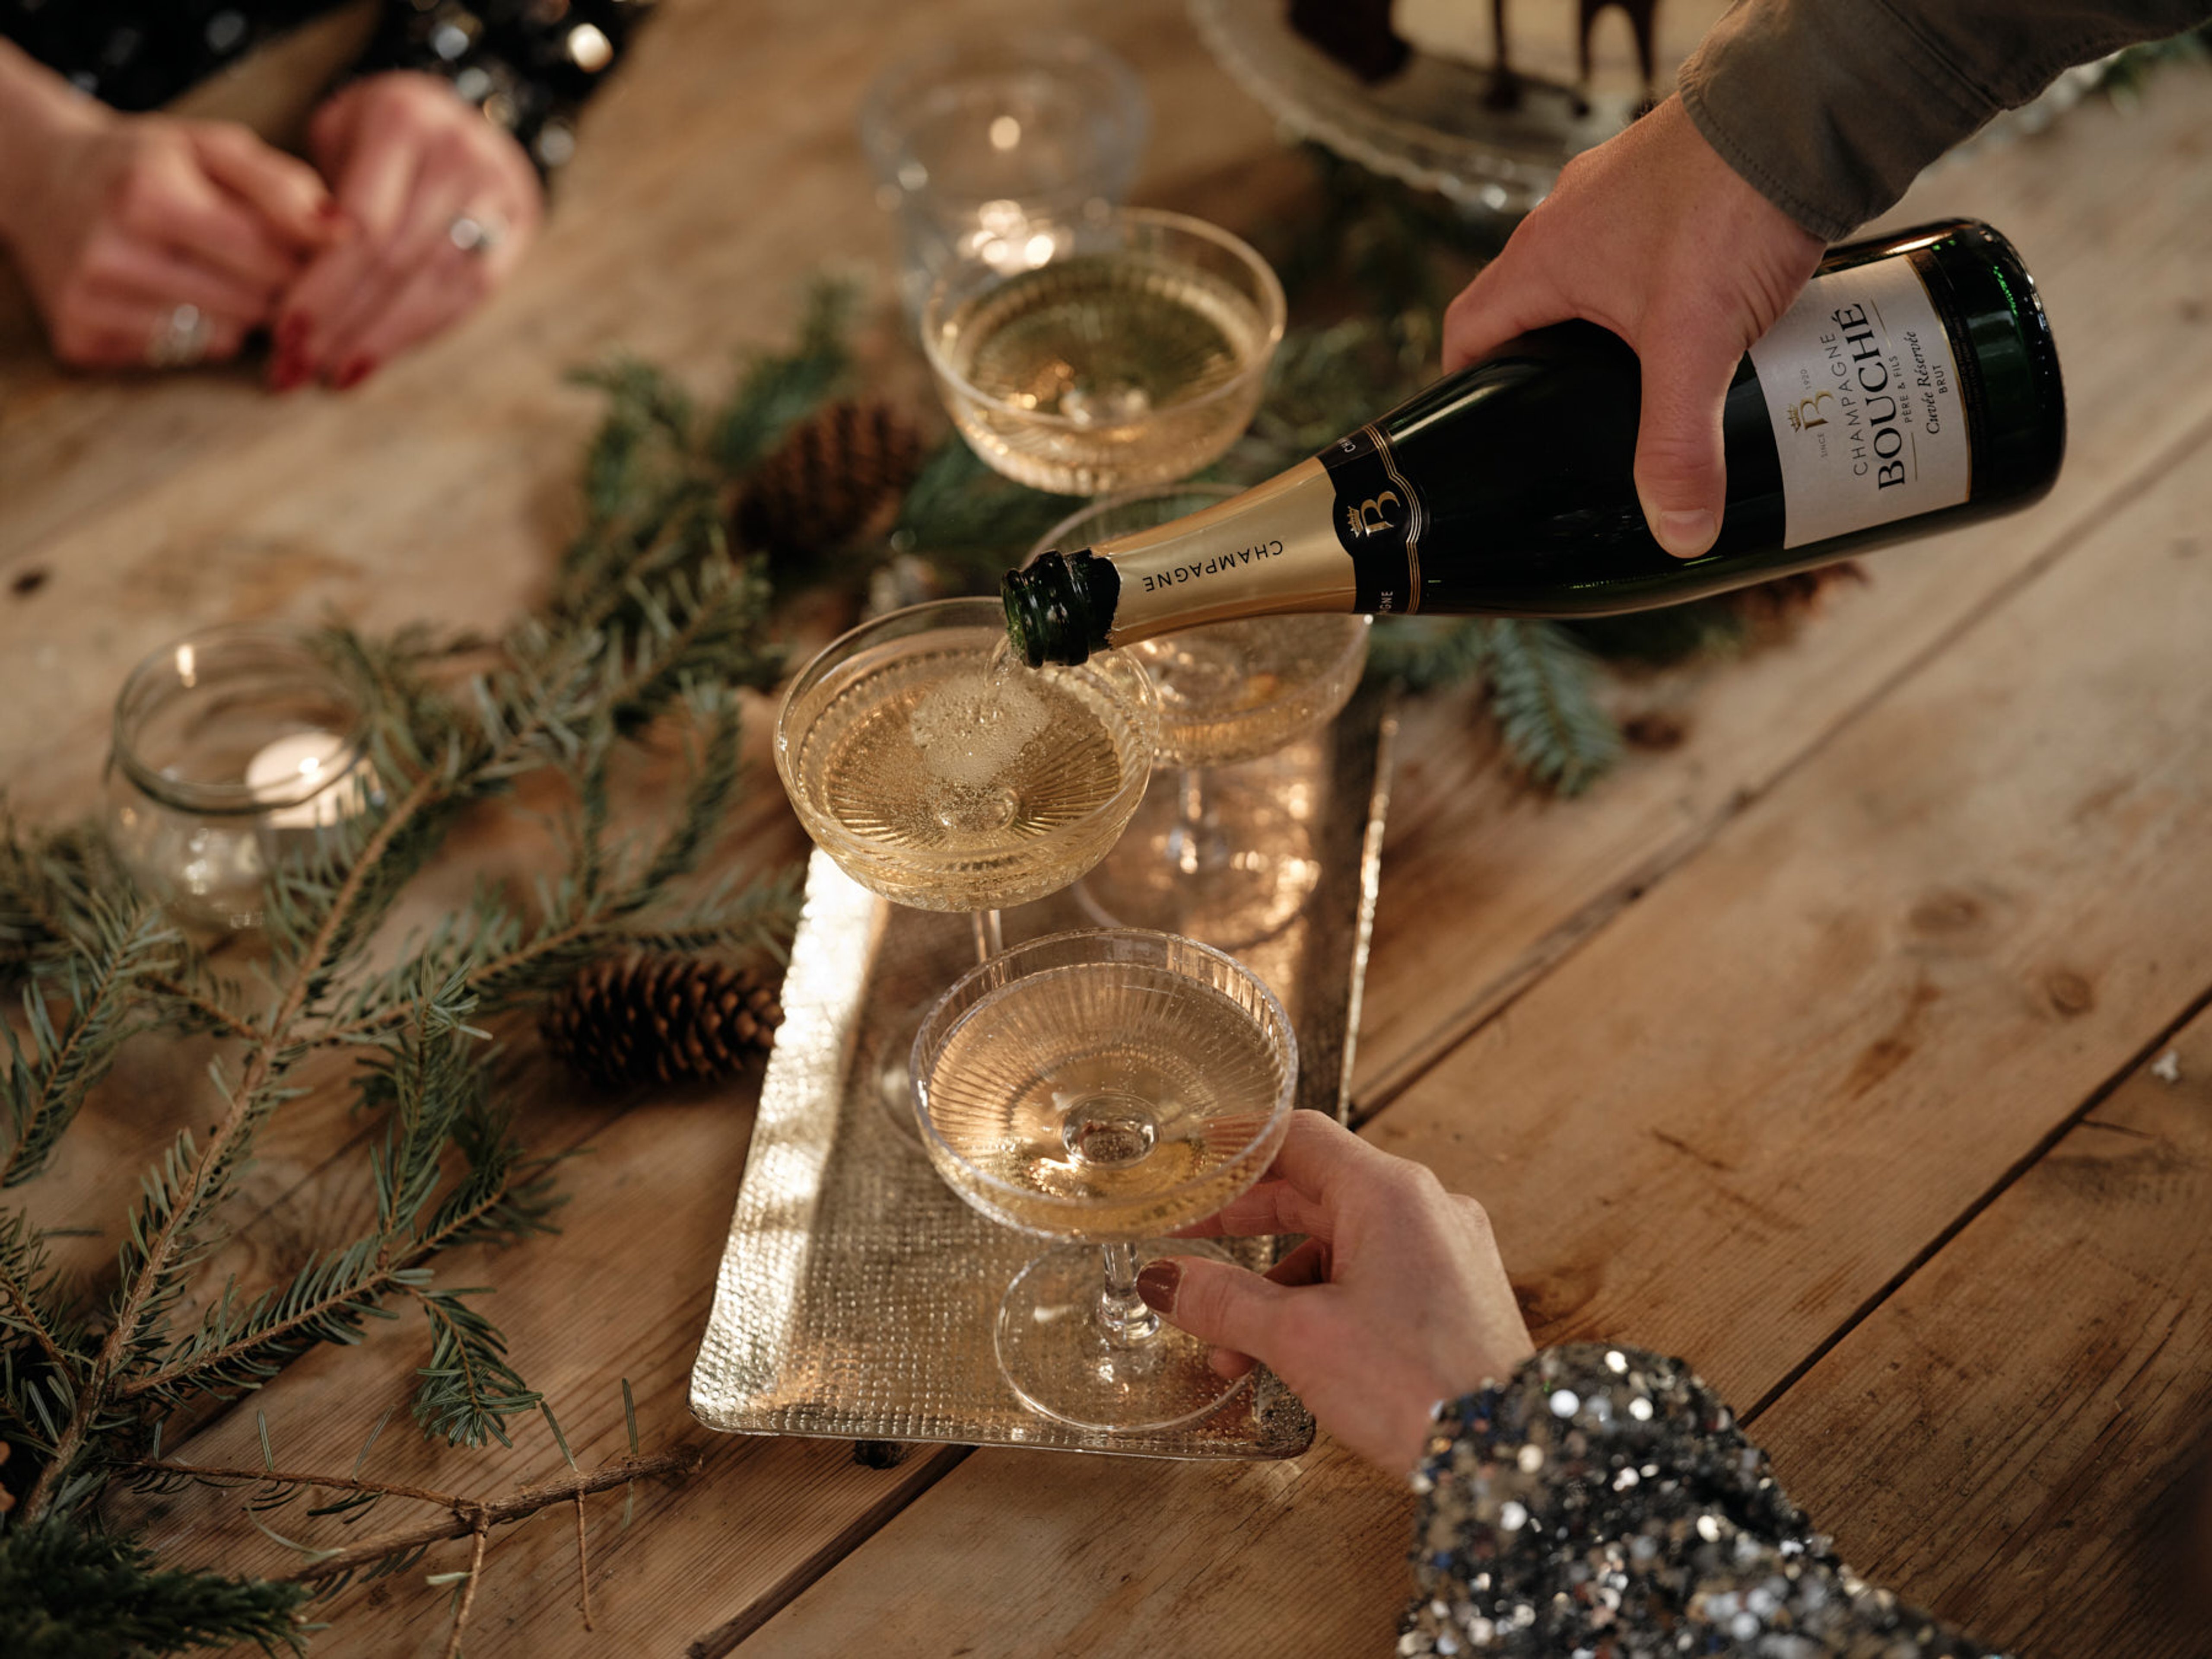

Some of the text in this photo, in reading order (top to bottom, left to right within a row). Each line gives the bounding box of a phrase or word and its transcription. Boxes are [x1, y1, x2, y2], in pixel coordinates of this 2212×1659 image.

[1889, 356, 1902, 378] FILS
[1904, 331, 1940, 434] Cuvée Réservée
[1933, 365, 1948, 394] BRUT
[1820, 333, 1868, 476] CHAMPAGNE
[1831, 304, 1905, 490] BOUCHÉ
[1817, 433, 1828, 459] SINCE
[1142, 540, 1283, 591] CHAMPAGNE
